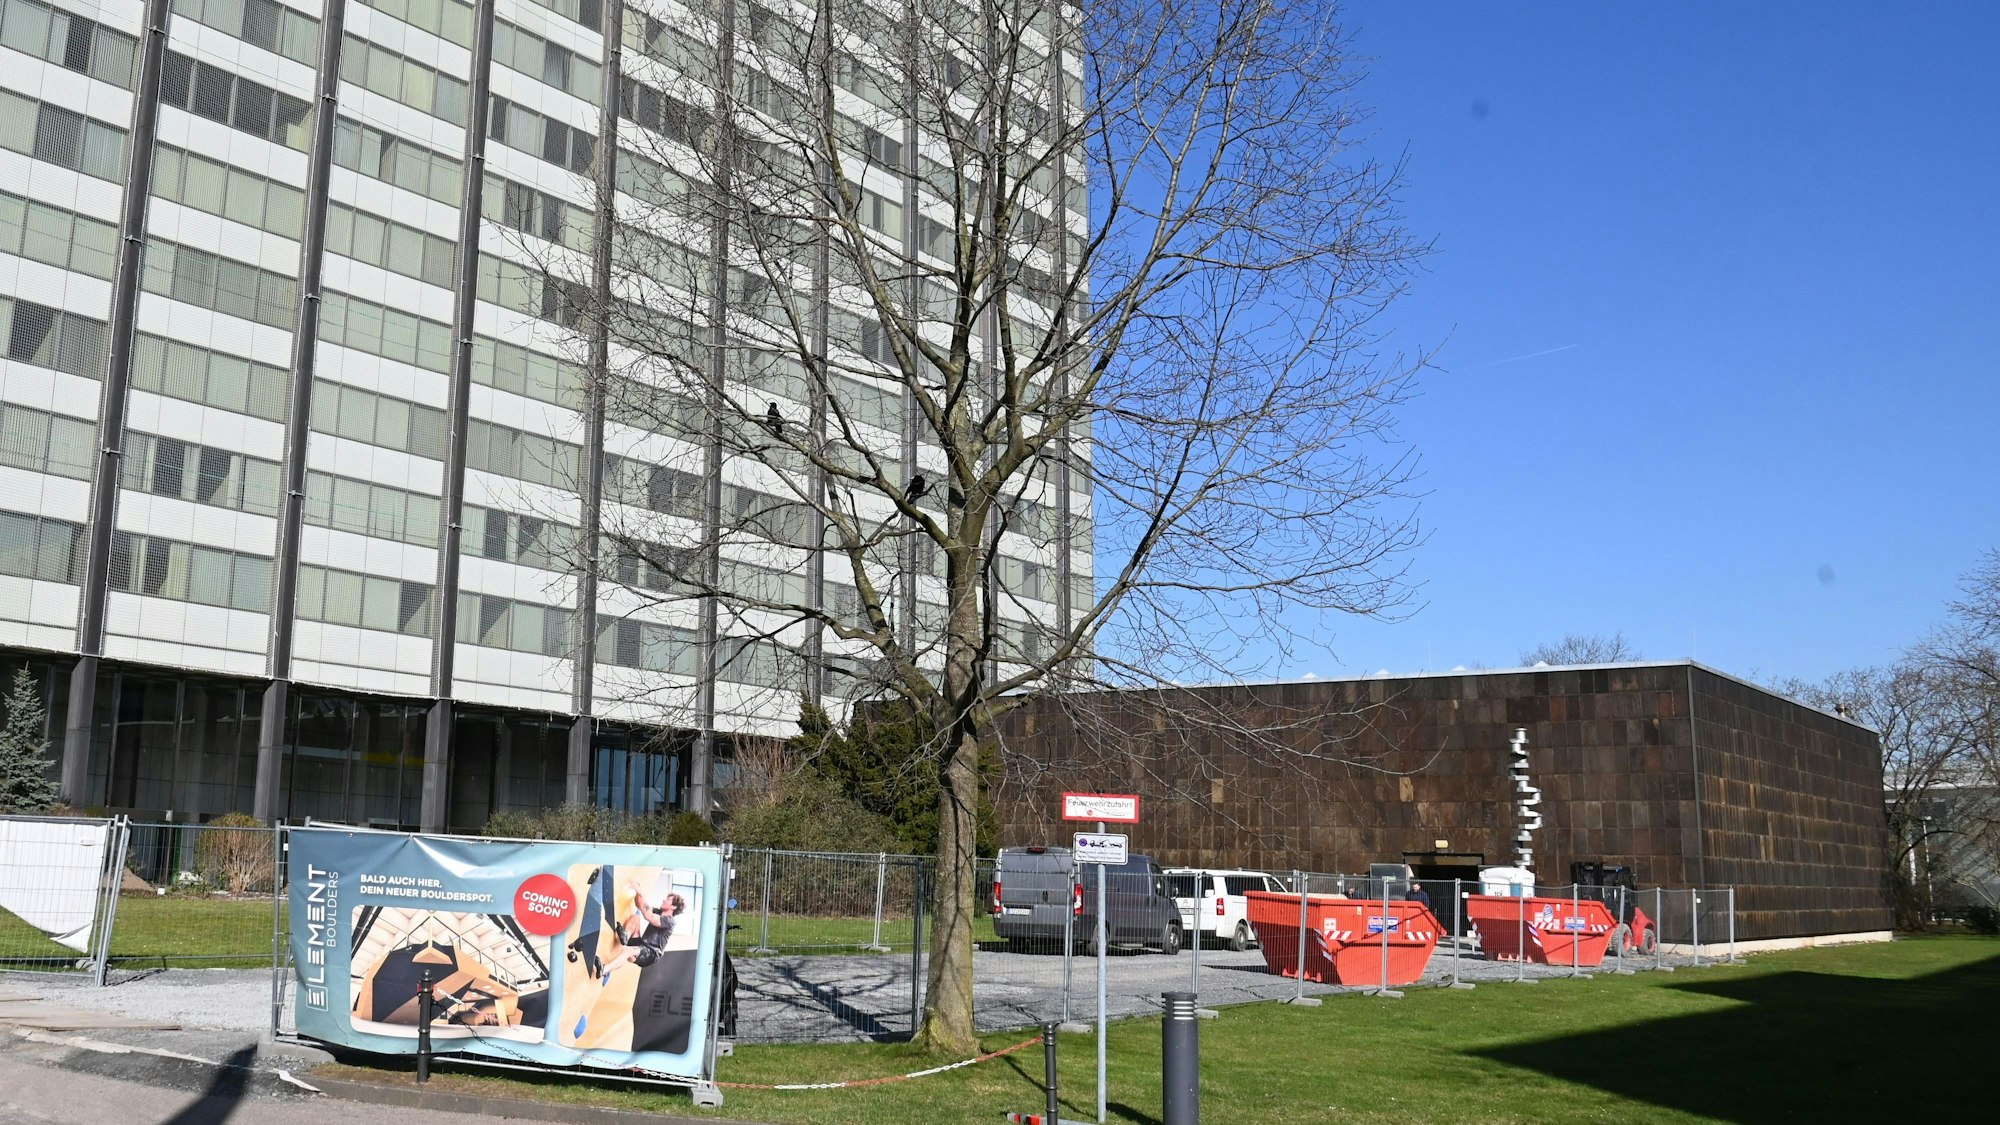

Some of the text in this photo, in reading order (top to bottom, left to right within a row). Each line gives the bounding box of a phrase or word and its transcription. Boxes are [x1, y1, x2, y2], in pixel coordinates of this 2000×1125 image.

[360, 874, 443, 889] BALD AUCH HIER.
[360, 885, 495, 903] DEIN NEUER BOULDERSPOT.
[522, 890, 569, 910] COMING
[326, 871, 339, 948] BOULDERS
[528, 901, 561, 918] SOON
[307, 863, 327, 1007] ELEMENT
